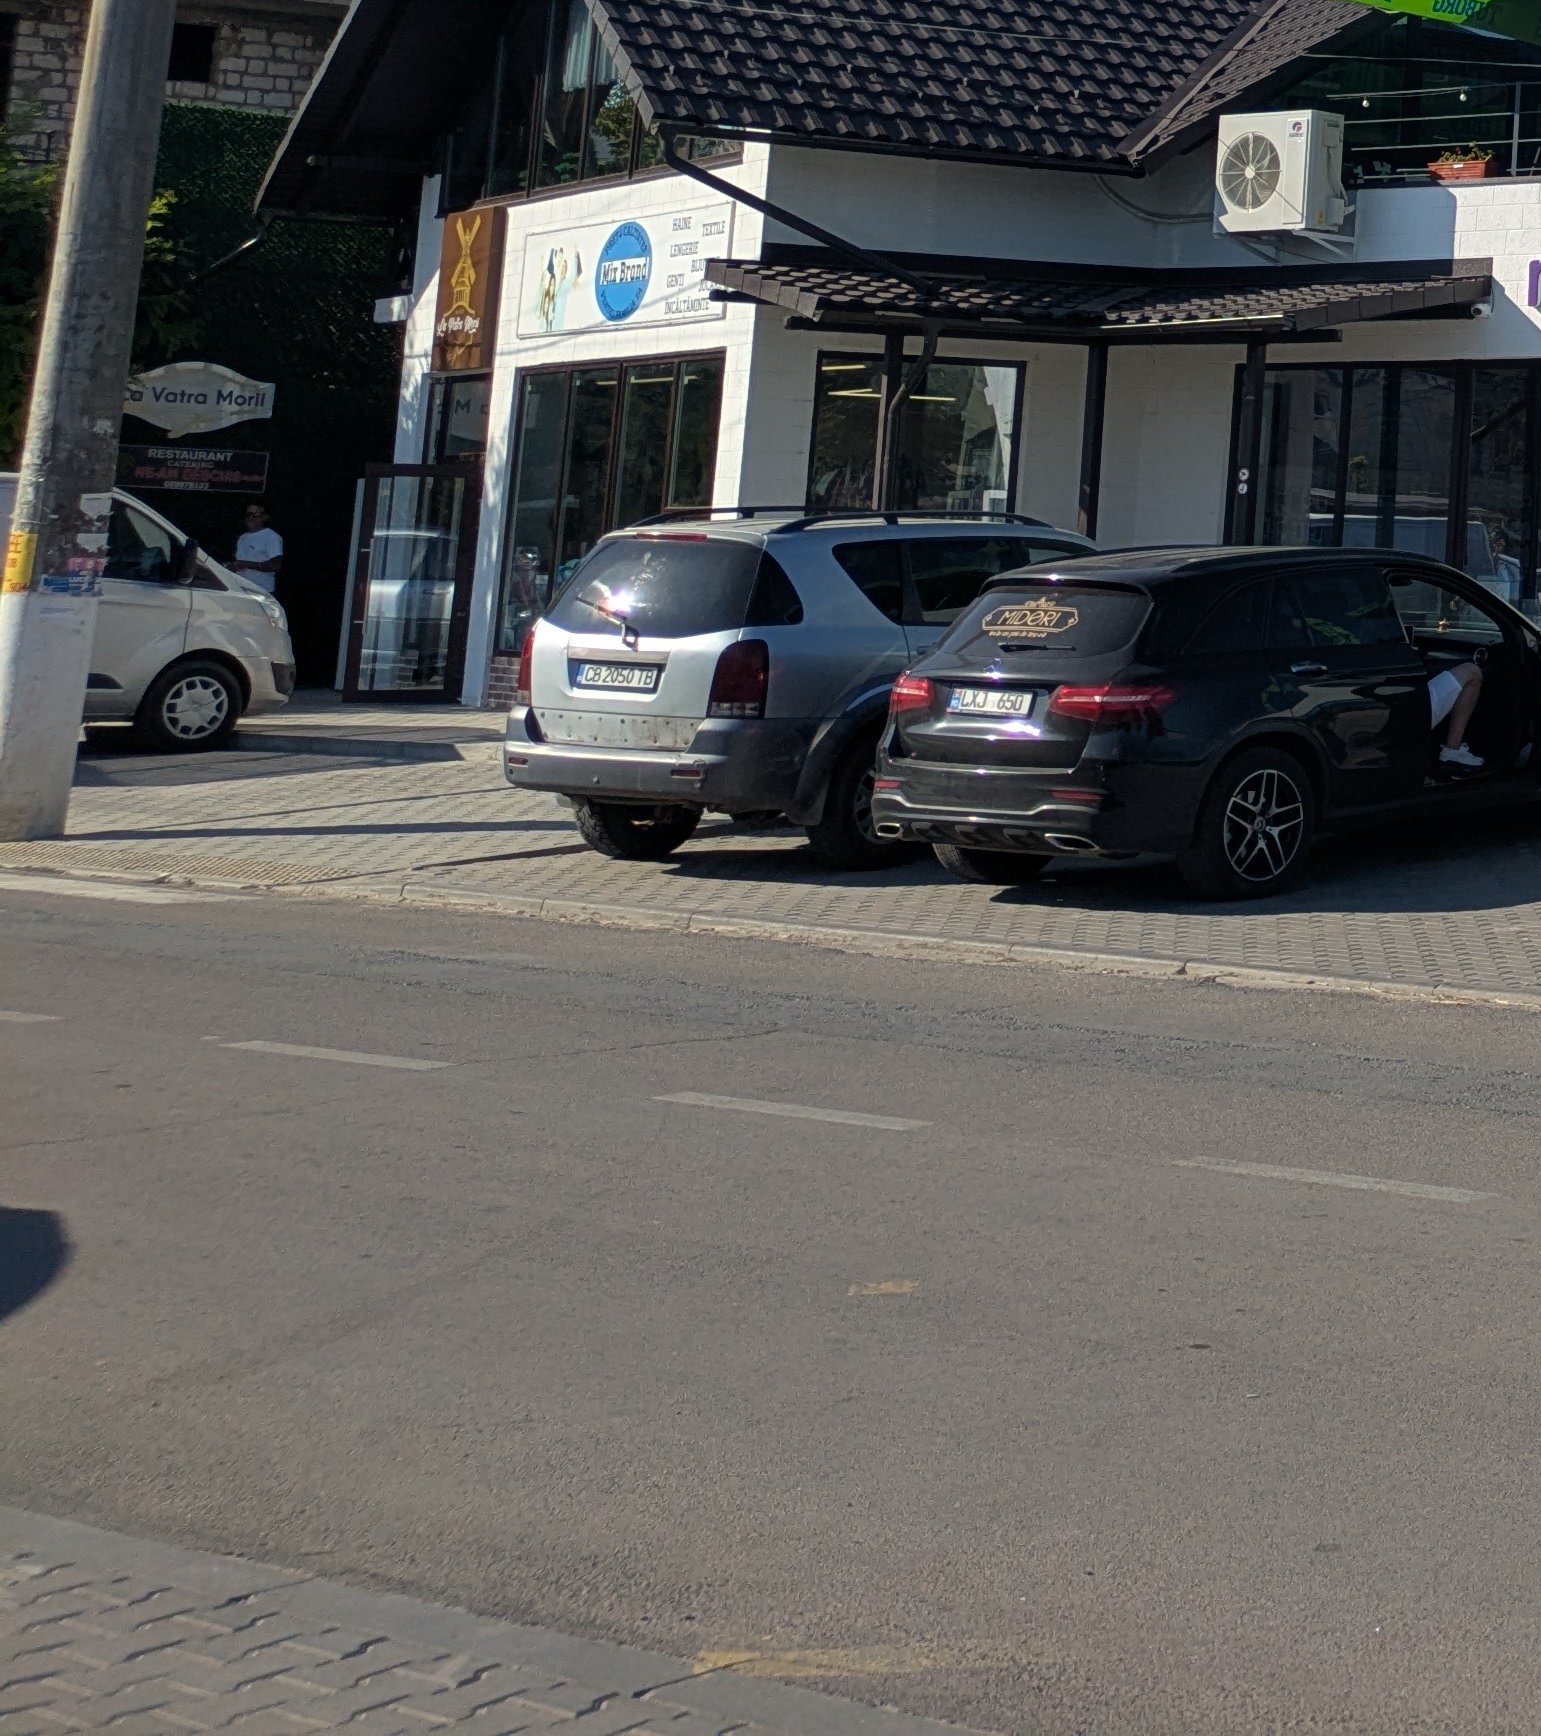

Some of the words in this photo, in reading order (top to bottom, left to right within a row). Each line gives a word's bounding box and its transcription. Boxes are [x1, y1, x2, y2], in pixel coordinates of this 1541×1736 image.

[672, 216, 692, 232] HAINE
[702, 221, 726, 237] TEXTILE
[670, 241, 699, 257] LENGERIE
[601, 262, 619, 285] Mix
[620, 257, 648, 282] Brand
[152, 387, 208, 405] Vatra
[147, 449, 233, 462] RESTAURANT
[584, 666, 602, 682] CB
[602, 667, 635, 684] 2050
[638, 669, 654, 686] TB
[960, 691, 989, 708] LXJ
[996, 694, 1024, 711] 650
